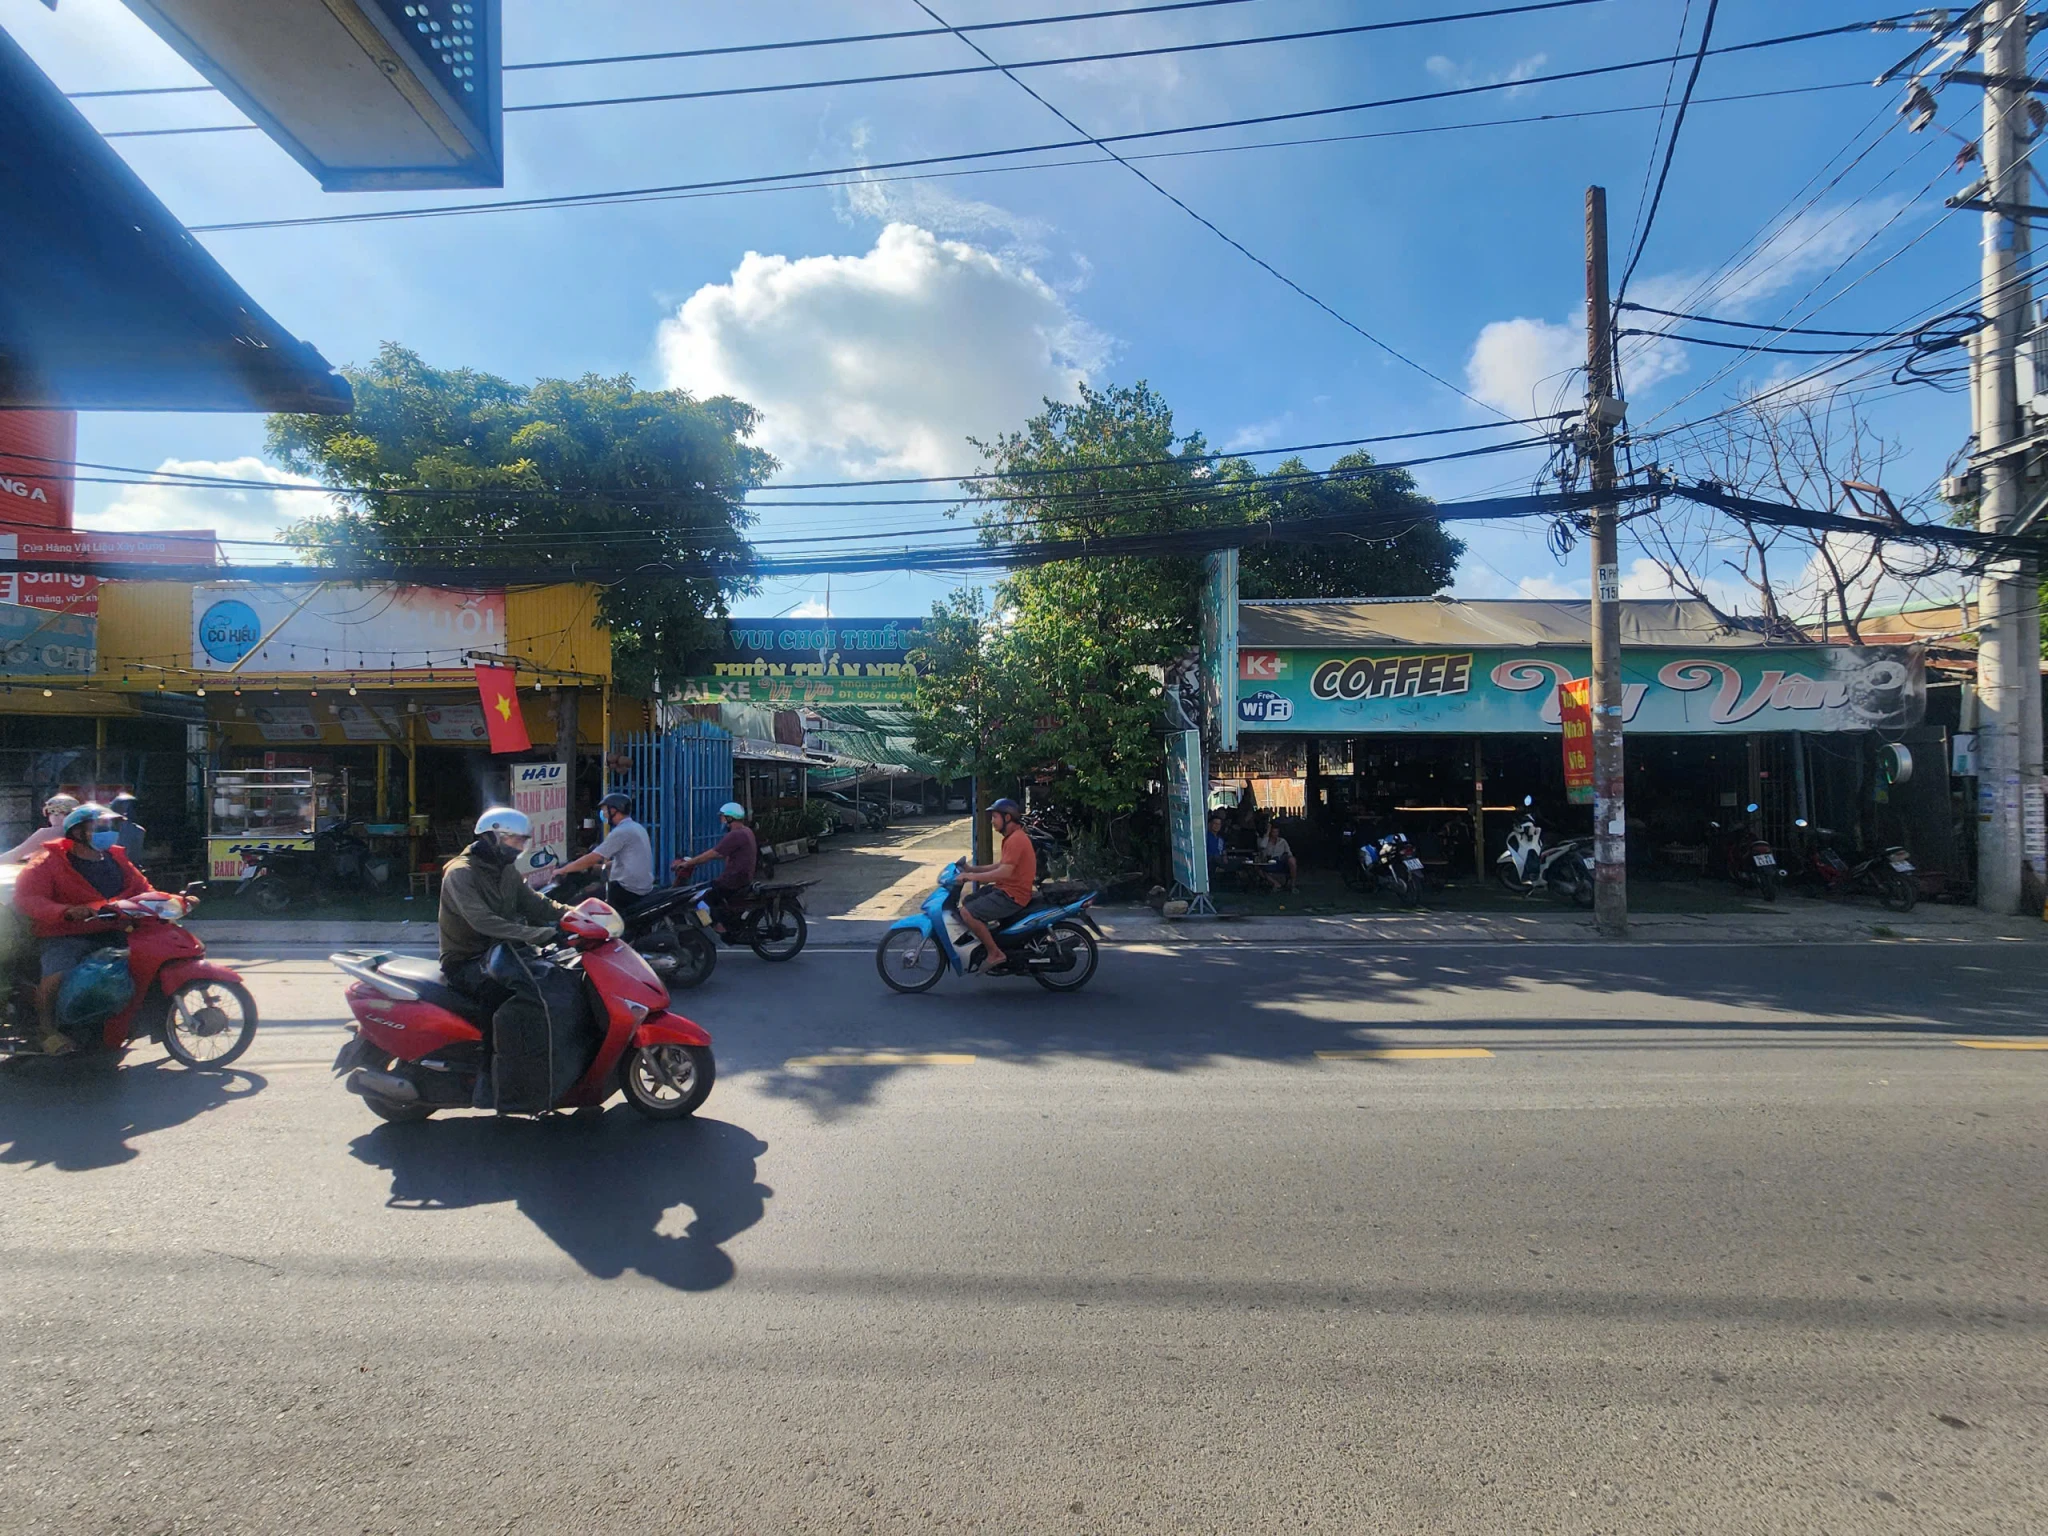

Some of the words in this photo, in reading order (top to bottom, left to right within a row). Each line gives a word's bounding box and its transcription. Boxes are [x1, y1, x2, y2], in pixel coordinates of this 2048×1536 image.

[730, 630, 773, 650] VUI
[1247, 655, 1288, 675] K+
[1310, 653, 1473, 701] COFFEE
[719, 681, 750, 699] XE
[857, 691, 881, 699] 0967
[1658, 659, 1849, 724] Vân
[521, 765, 561, 781] HẬU
